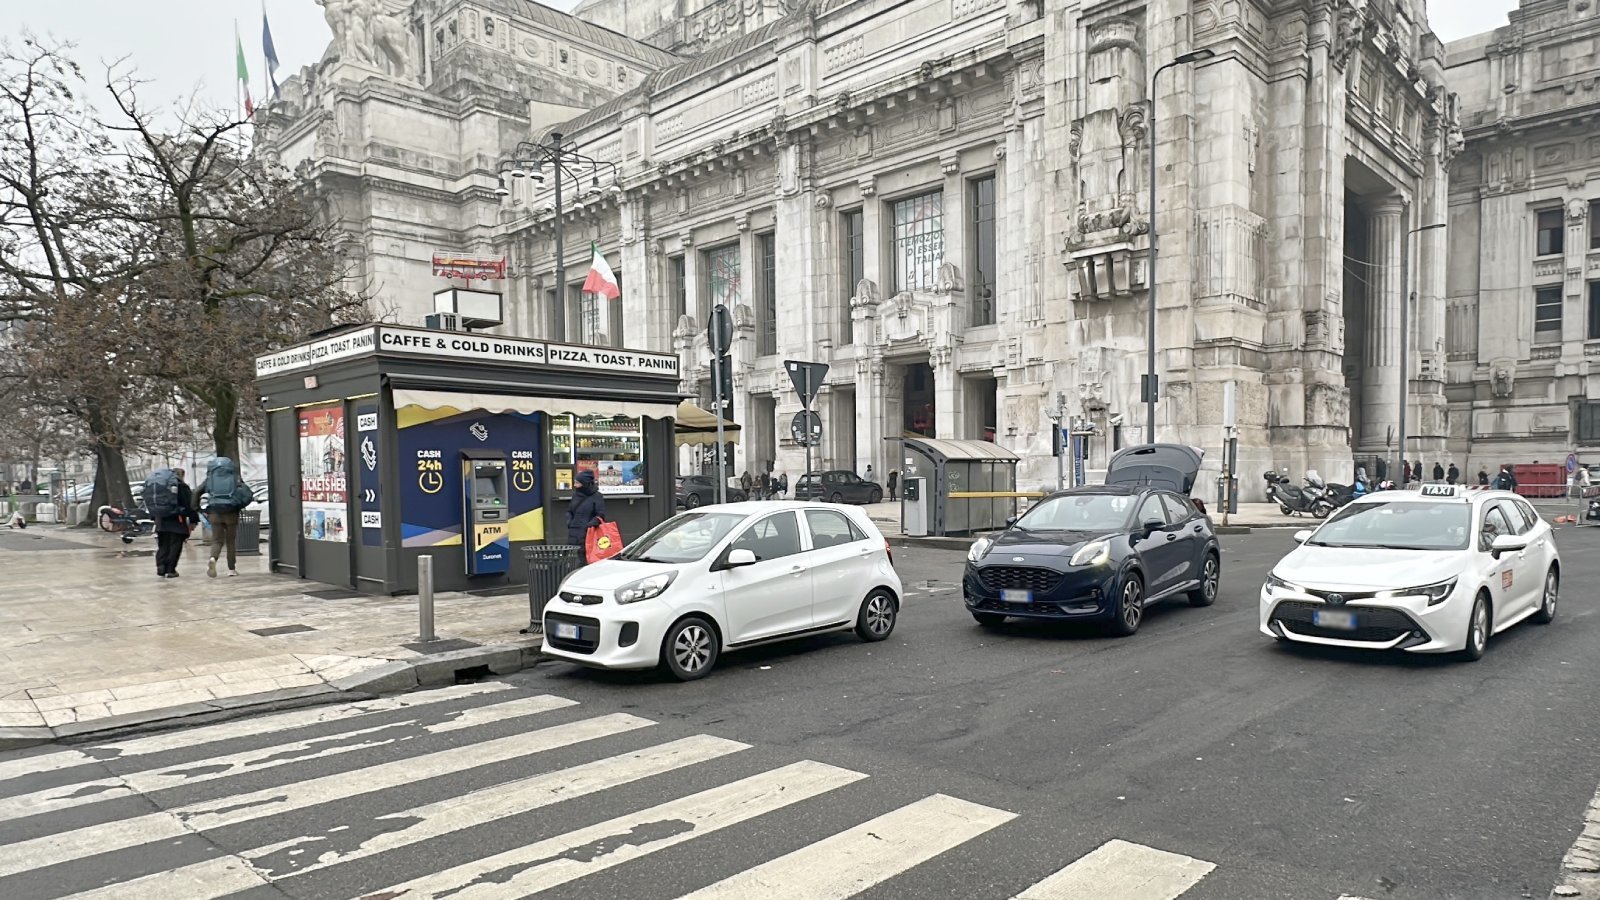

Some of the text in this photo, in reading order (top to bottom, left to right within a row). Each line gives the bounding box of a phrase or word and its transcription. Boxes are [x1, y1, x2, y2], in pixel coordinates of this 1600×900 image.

[382, 333, 543, 357] CAFFE & COLD DRINKS
[257, 359, 271, 370] CAFFE
[277, 354, 290, 367] COLD
[290, 351, 310, 364] DRINKS
[639, 357, 676, 370] PANINI
[360, 416, 376, 428] CASH
[417, 450, 441, 458] CASH
[512, 451, 533, 459] CASH
[418, 460, 442, 471] 24h
[512, 460, 533, 470] 24h
[302, 477, 330, 492] TICKETS
[1426, 486, 1451, 496] TAXI
[363, 514, 380, 525] CASH
[483, 527, 502, 535] ATM
